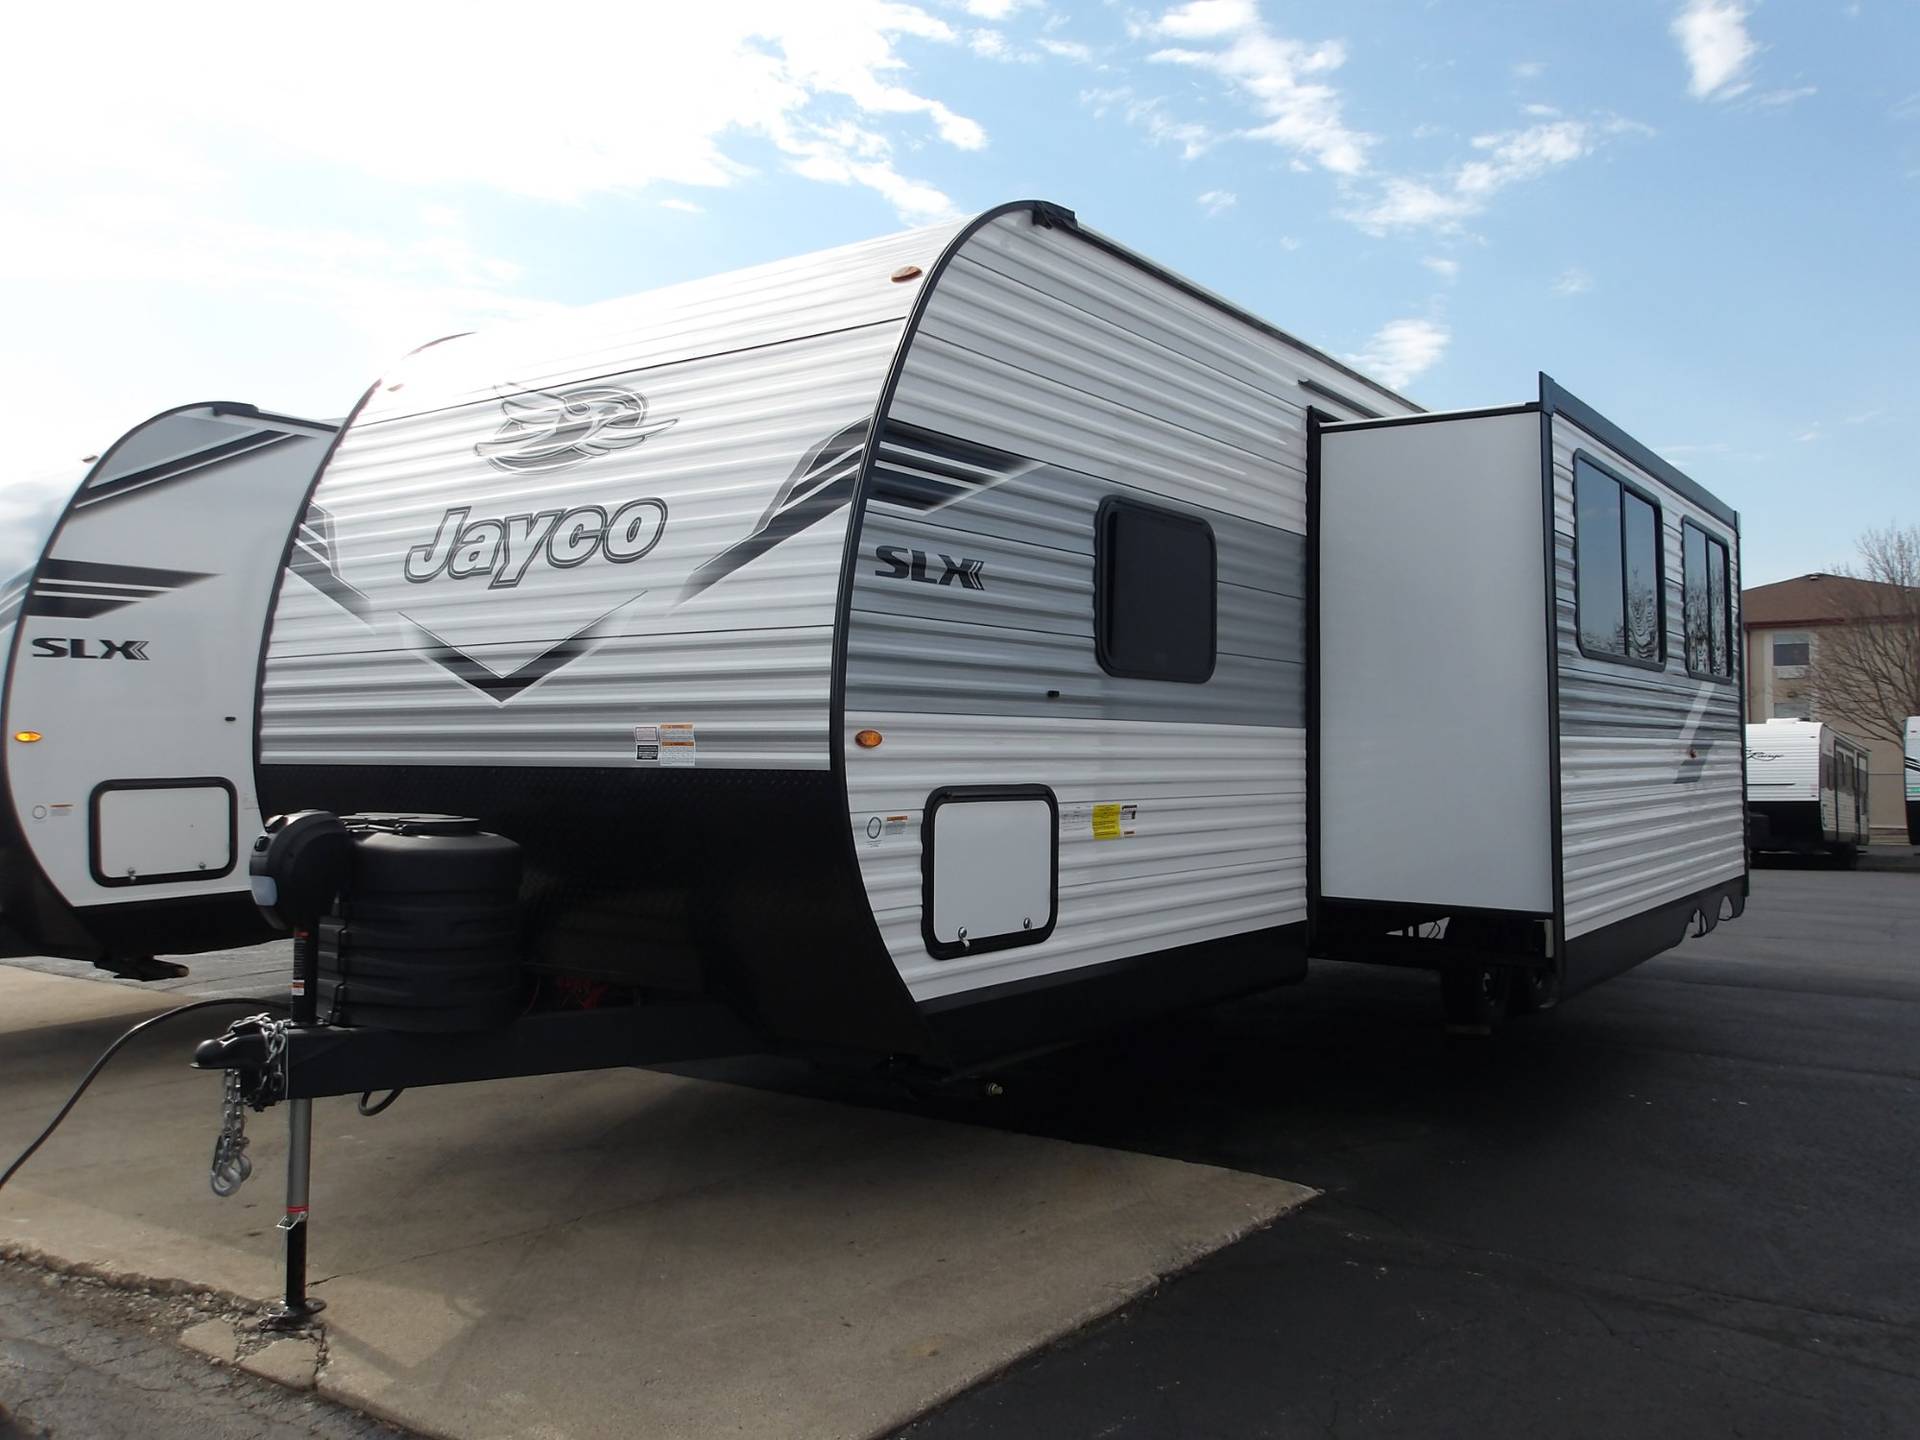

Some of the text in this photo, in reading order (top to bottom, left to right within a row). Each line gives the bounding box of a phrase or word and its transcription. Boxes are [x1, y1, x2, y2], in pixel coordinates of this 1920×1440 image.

[404, 497, 668, 590] Jayco
[875, 546, 985, 591] SLX
[32, 637, 150, 660] SLX
